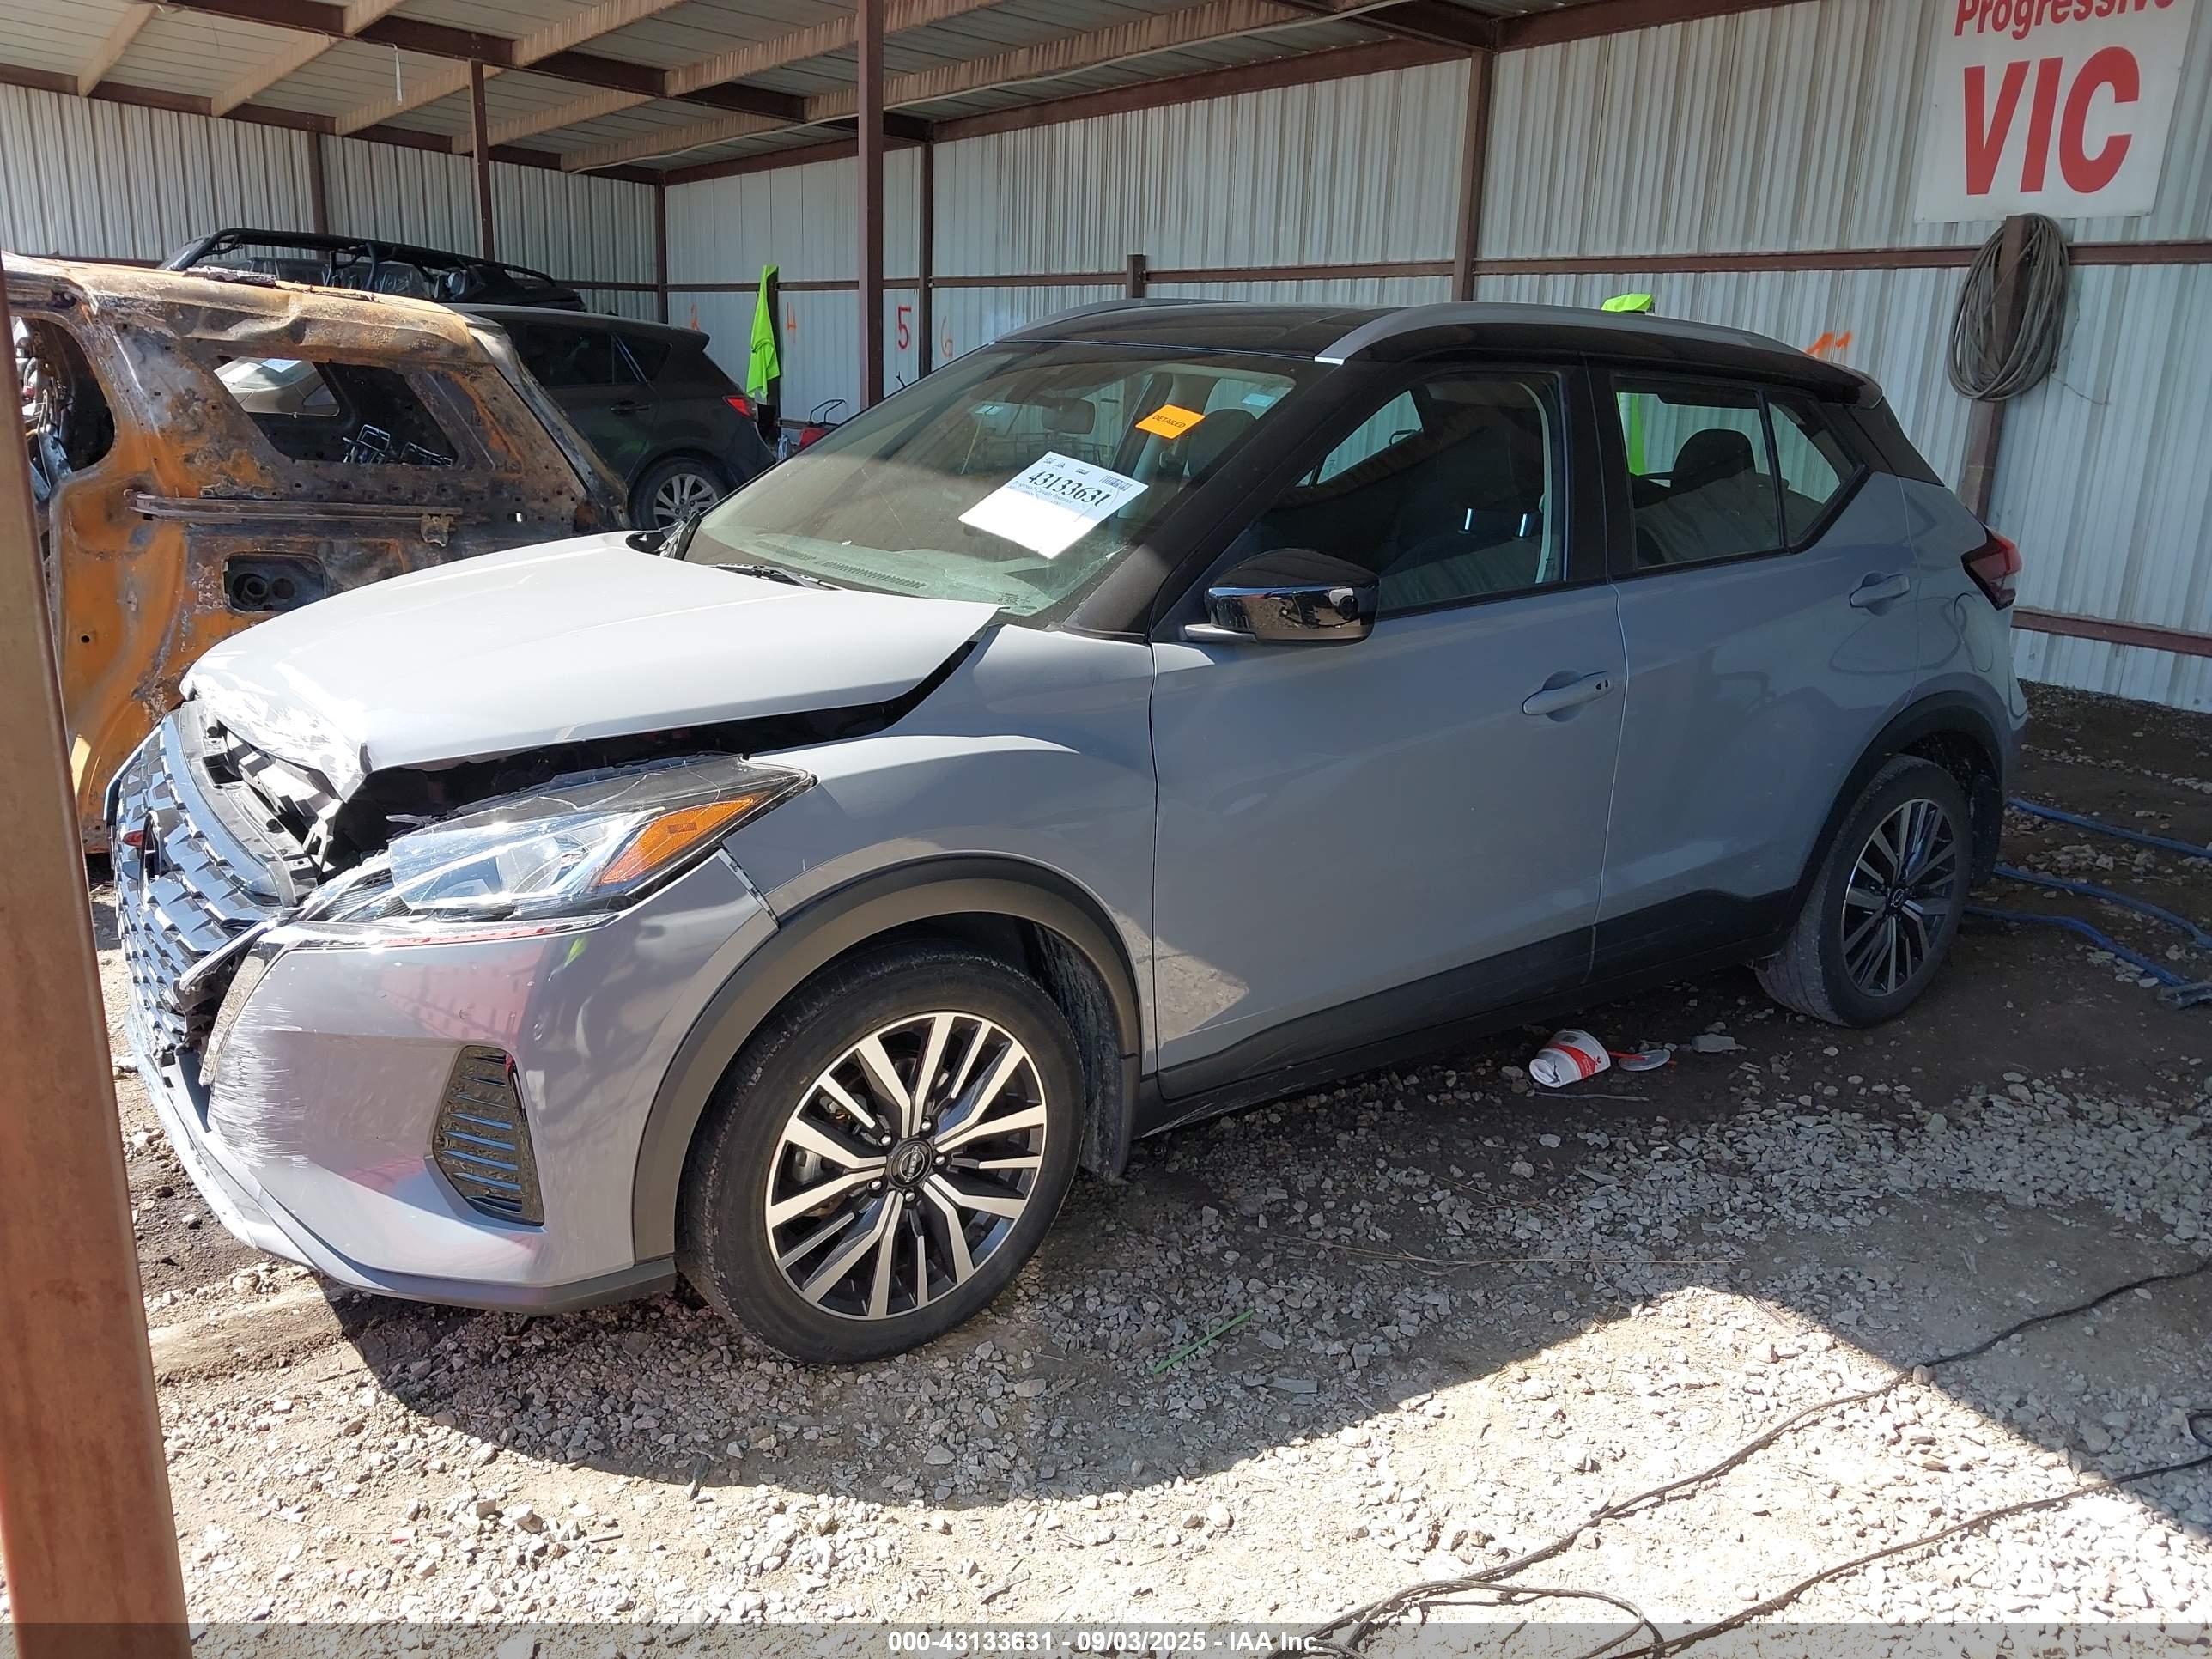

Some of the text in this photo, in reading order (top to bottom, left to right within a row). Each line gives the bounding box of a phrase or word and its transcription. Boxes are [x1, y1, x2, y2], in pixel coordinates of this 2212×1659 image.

[1964, 46, 2141, 195] VIC
[897, 306, 912, 349] 5
[940, 315, 953, 357] 6
[1152, 415, 1186, 428] DETAILED
[1028, 471, 1112, 507] 43133631
[904, 1146, 921, 1183] NISSAN
